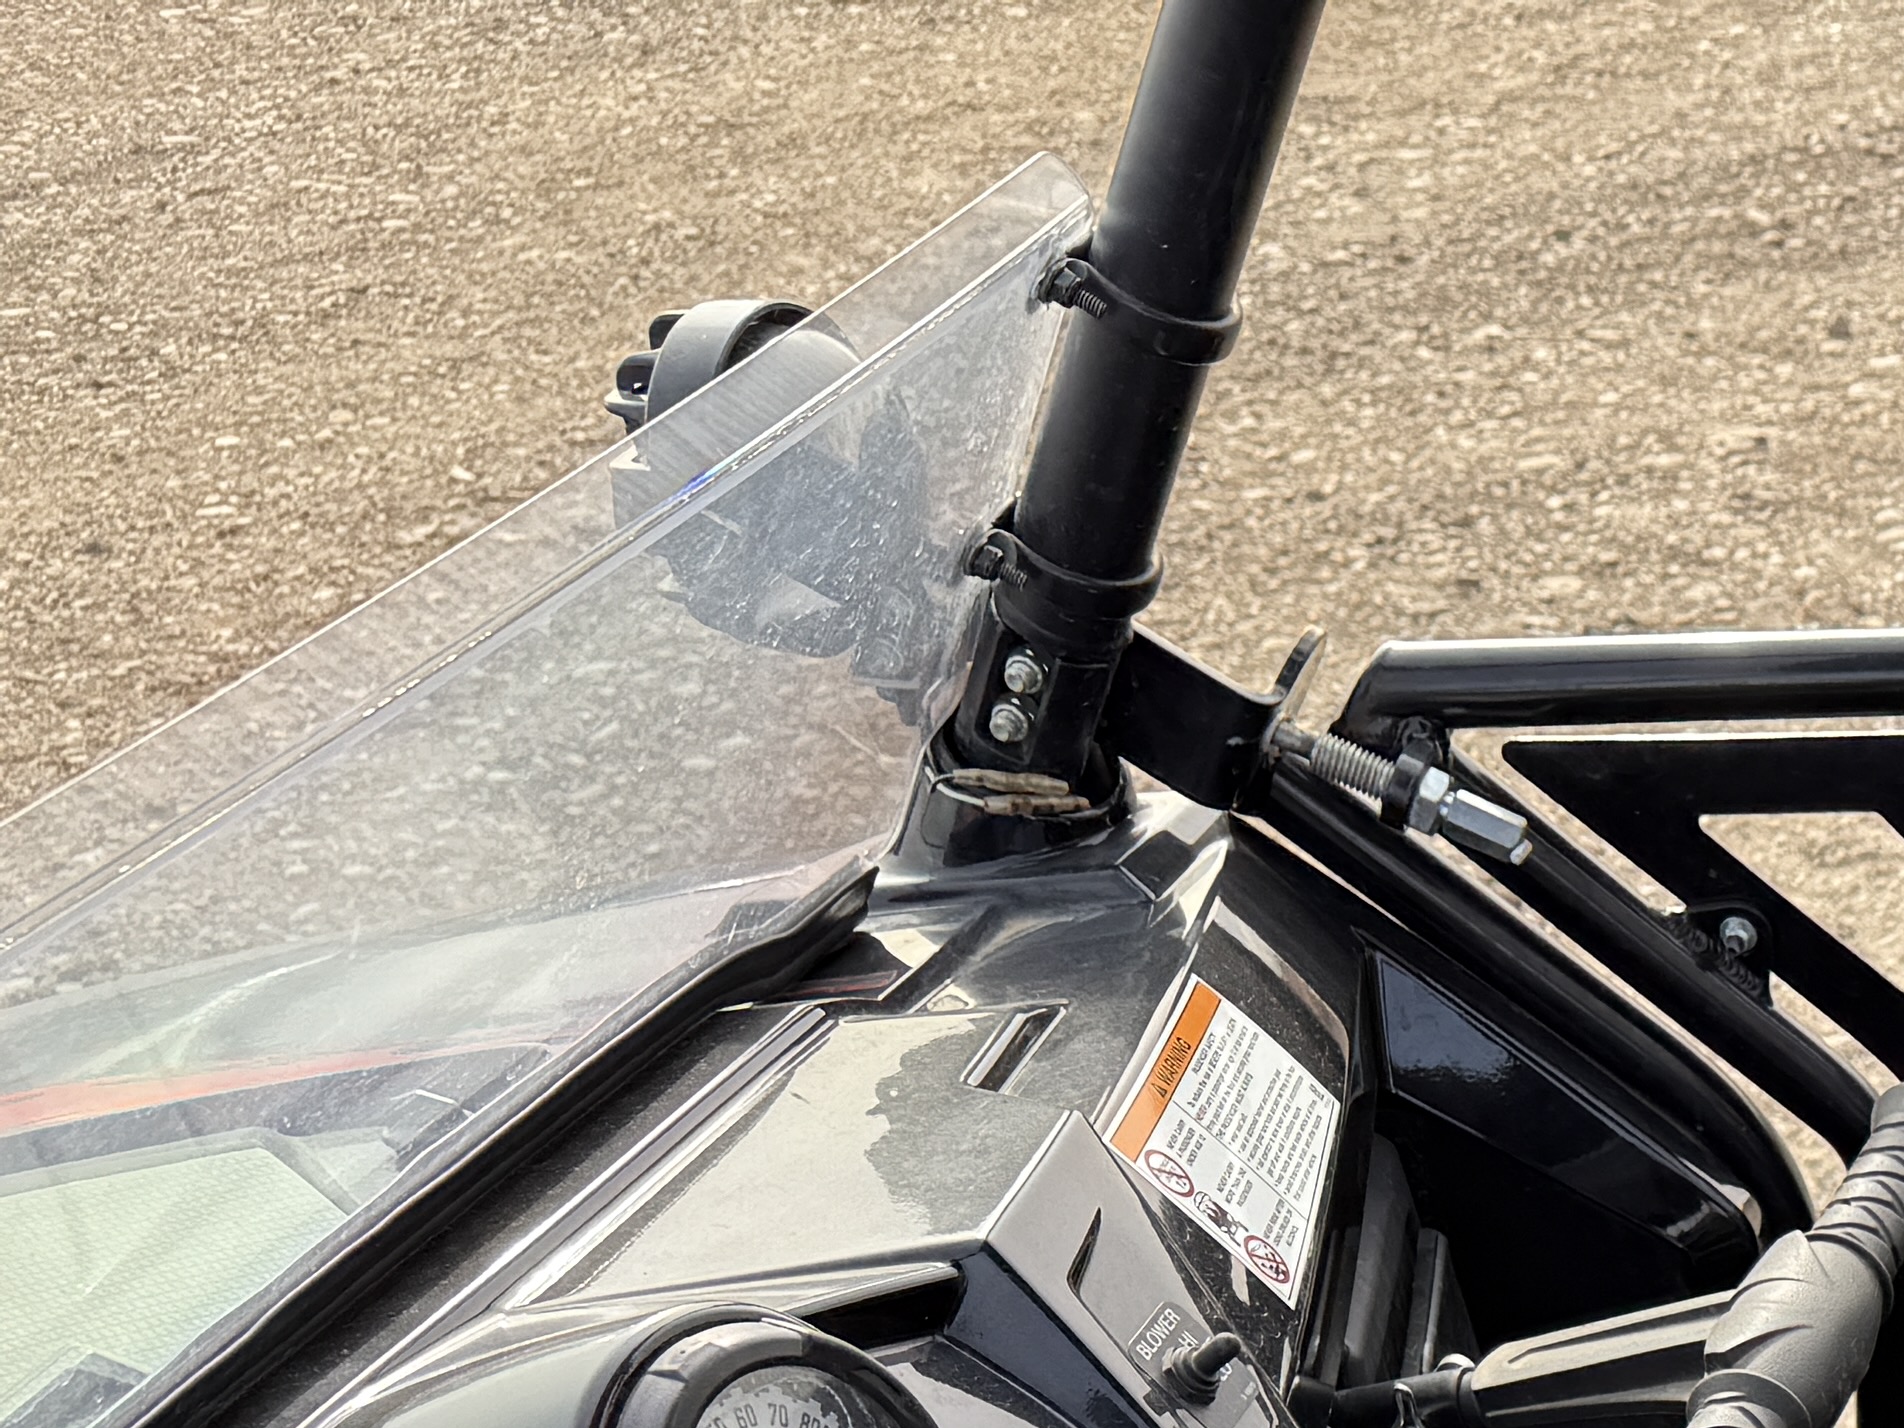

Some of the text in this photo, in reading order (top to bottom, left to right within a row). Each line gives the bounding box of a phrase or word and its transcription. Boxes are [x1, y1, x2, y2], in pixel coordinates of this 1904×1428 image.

[1156, 1037, 1191, 1086] WARNING
[1136, 1308, 1181, 1361] BLOWER
[768, 1403, 789, 1427] 70
